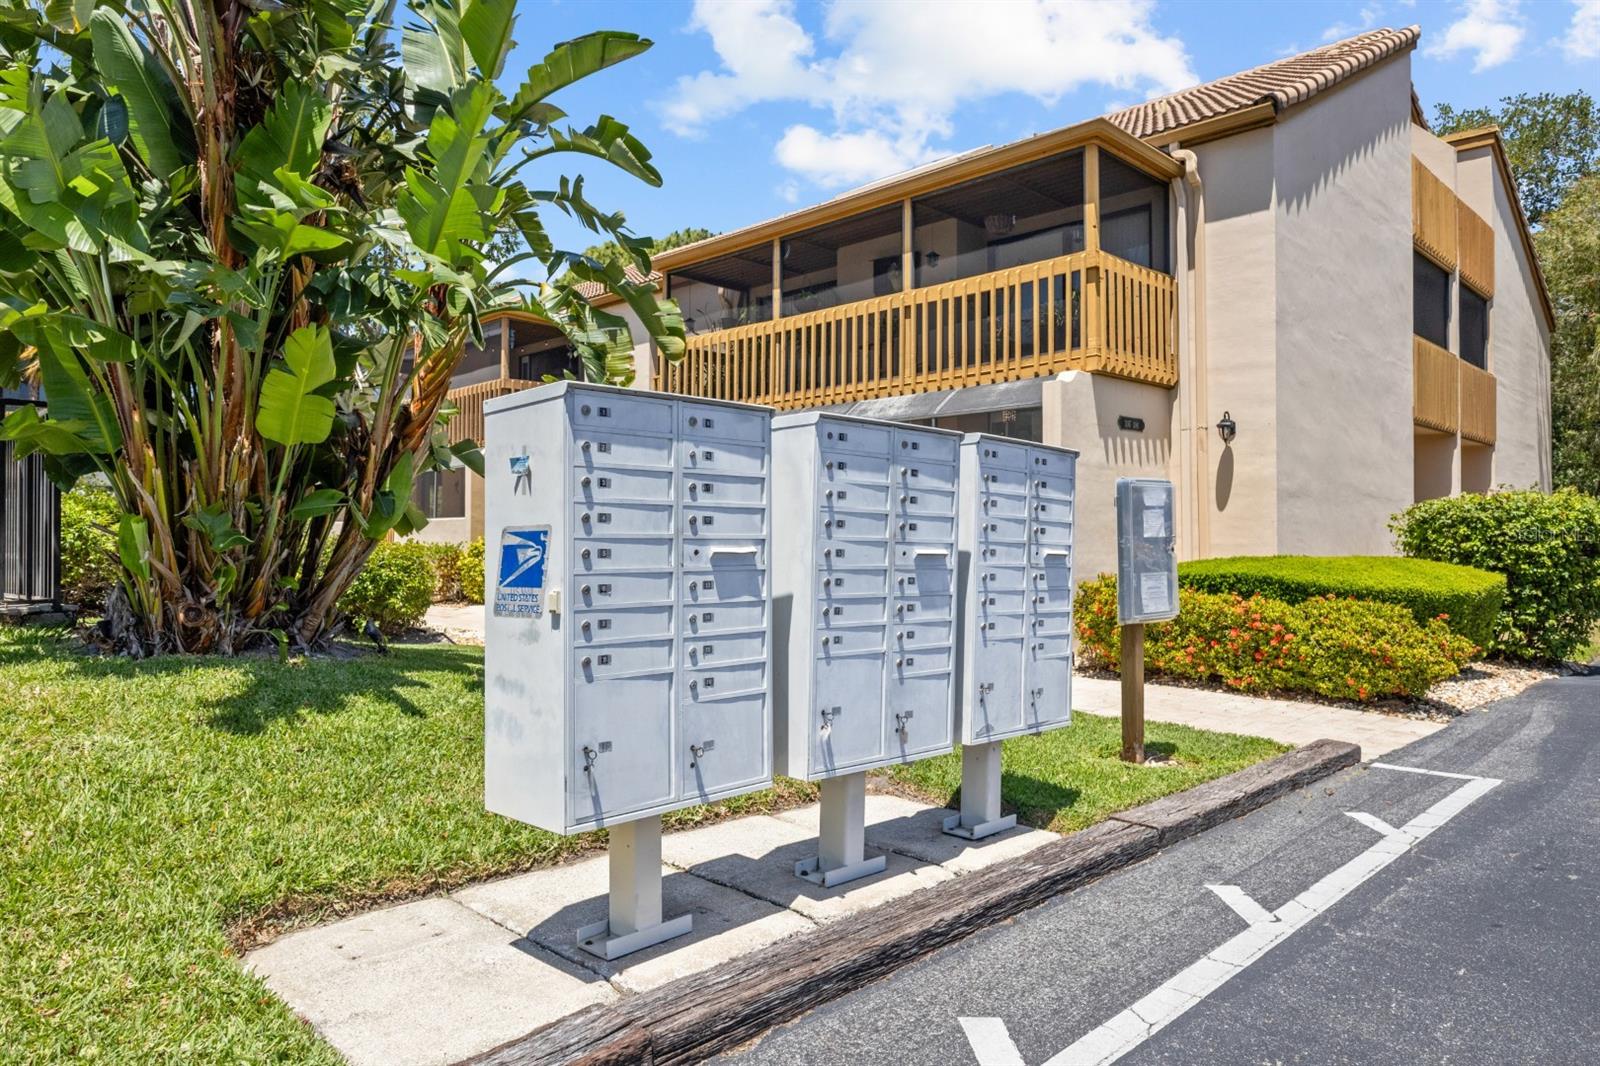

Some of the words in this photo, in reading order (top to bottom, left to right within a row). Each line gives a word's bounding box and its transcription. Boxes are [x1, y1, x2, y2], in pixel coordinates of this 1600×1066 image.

[497, 593, 518, 602] UNITED
[518, 593, 539, 603] STATES
[517, 604, 541, 614] SERVICE
